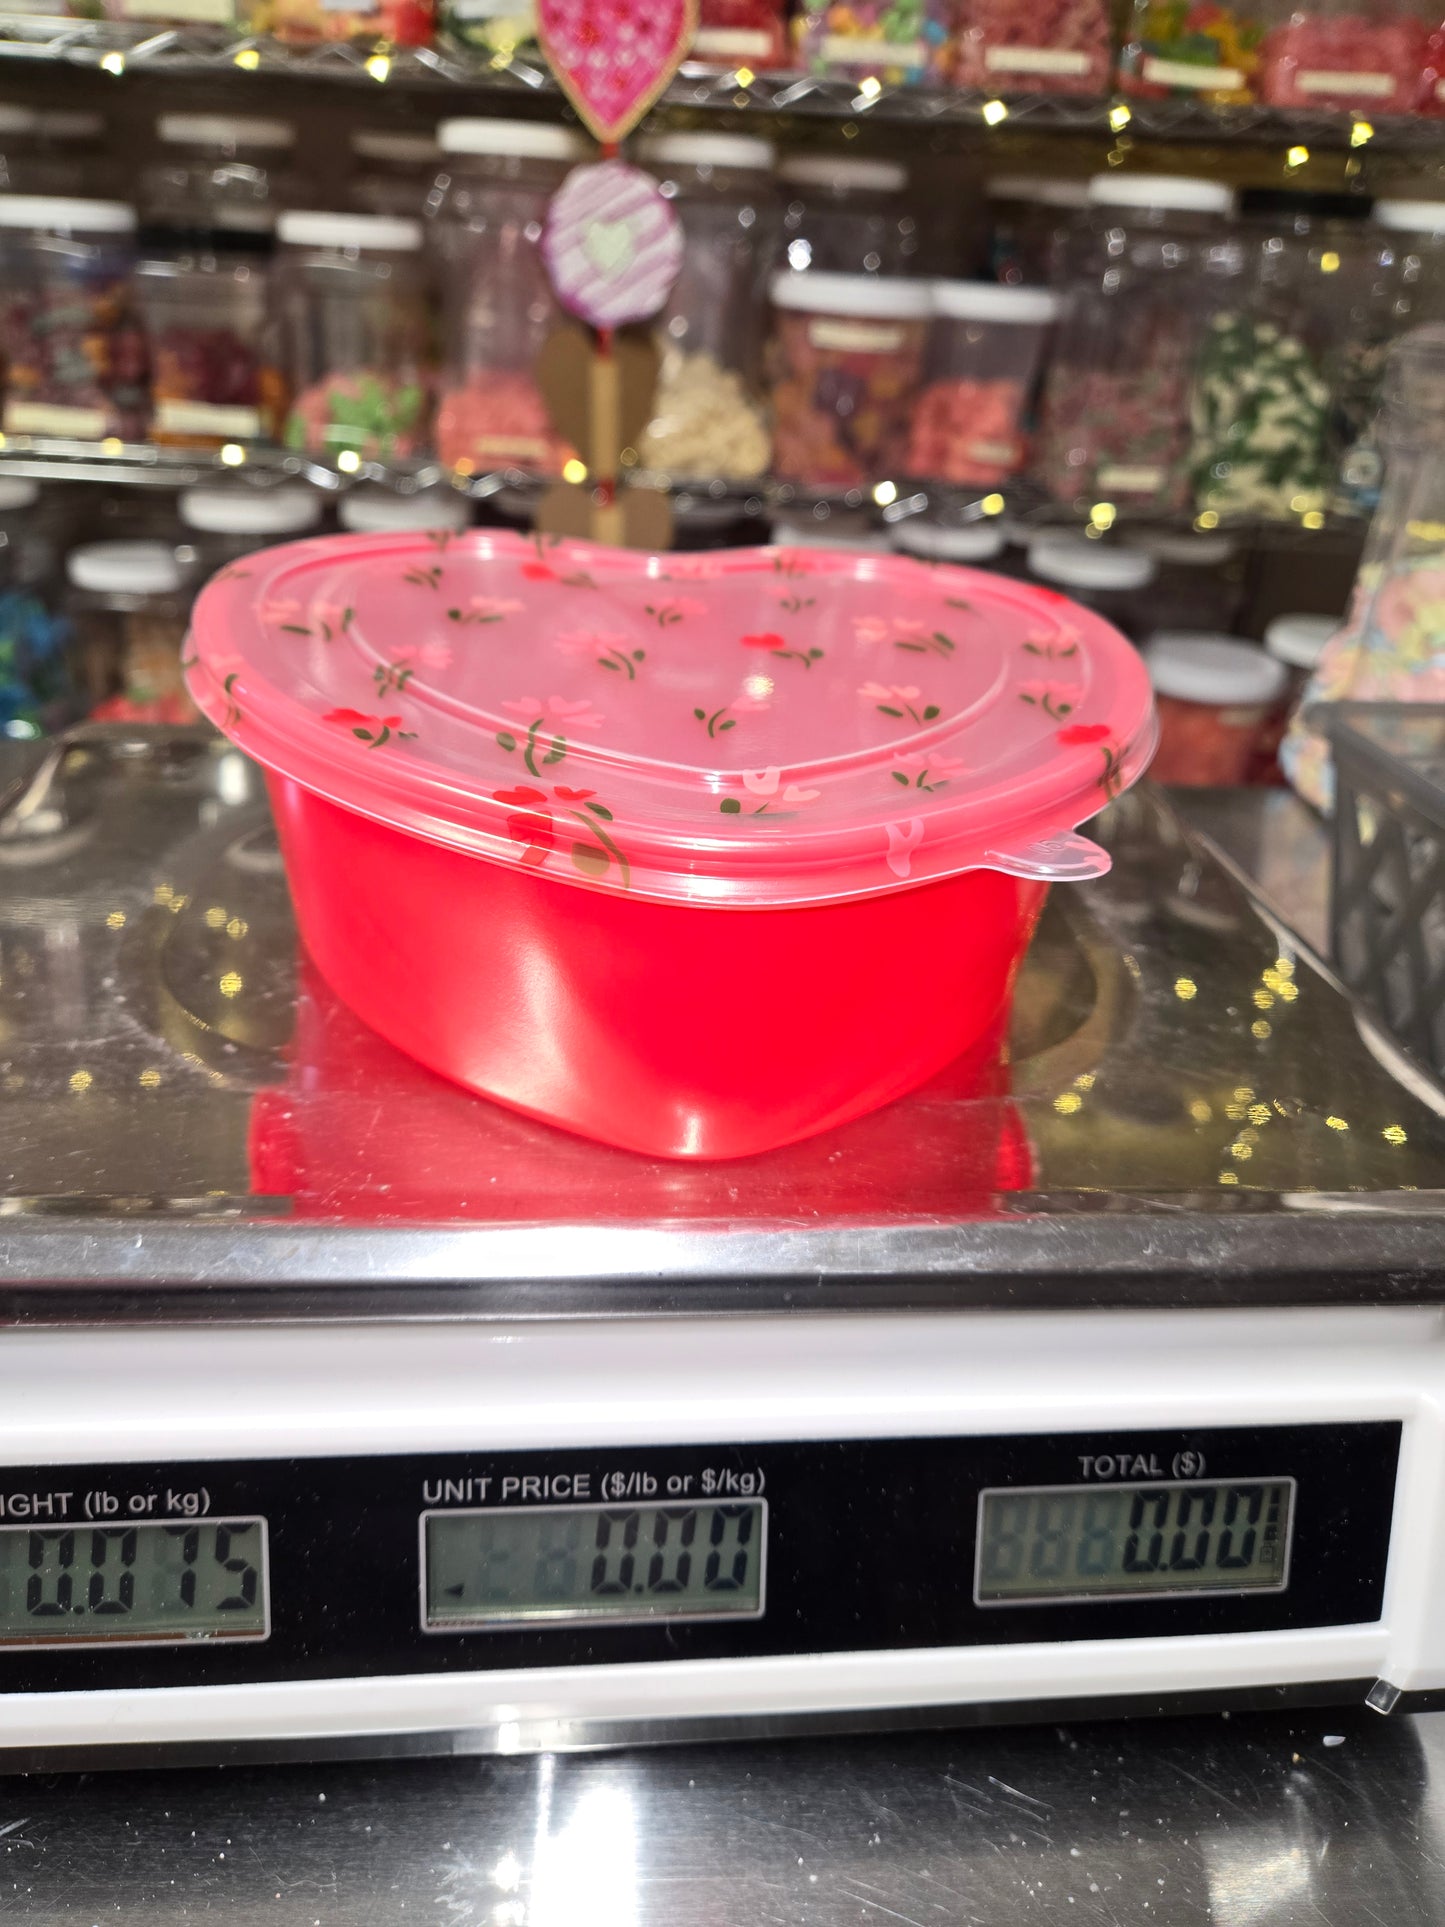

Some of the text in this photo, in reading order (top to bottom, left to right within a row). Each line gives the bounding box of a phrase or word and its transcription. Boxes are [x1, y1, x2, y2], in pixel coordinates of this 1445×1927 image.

[423, 1468, 766, 1502] UNIT PRICE ($/lb or $/kg)
[1078, 1451, 1206, 1479] TOTAL ($)
[84, 1490, 119, 1518] (lb
[129, 1493, 158, 1513] or
[167, 1487, 211, 1515] kg)
[1122, 1486, 1264, 1574] 0.00
[27, 1523, 259, 1616] 0.075
[591, 1506, 753, 1595] 0.00
